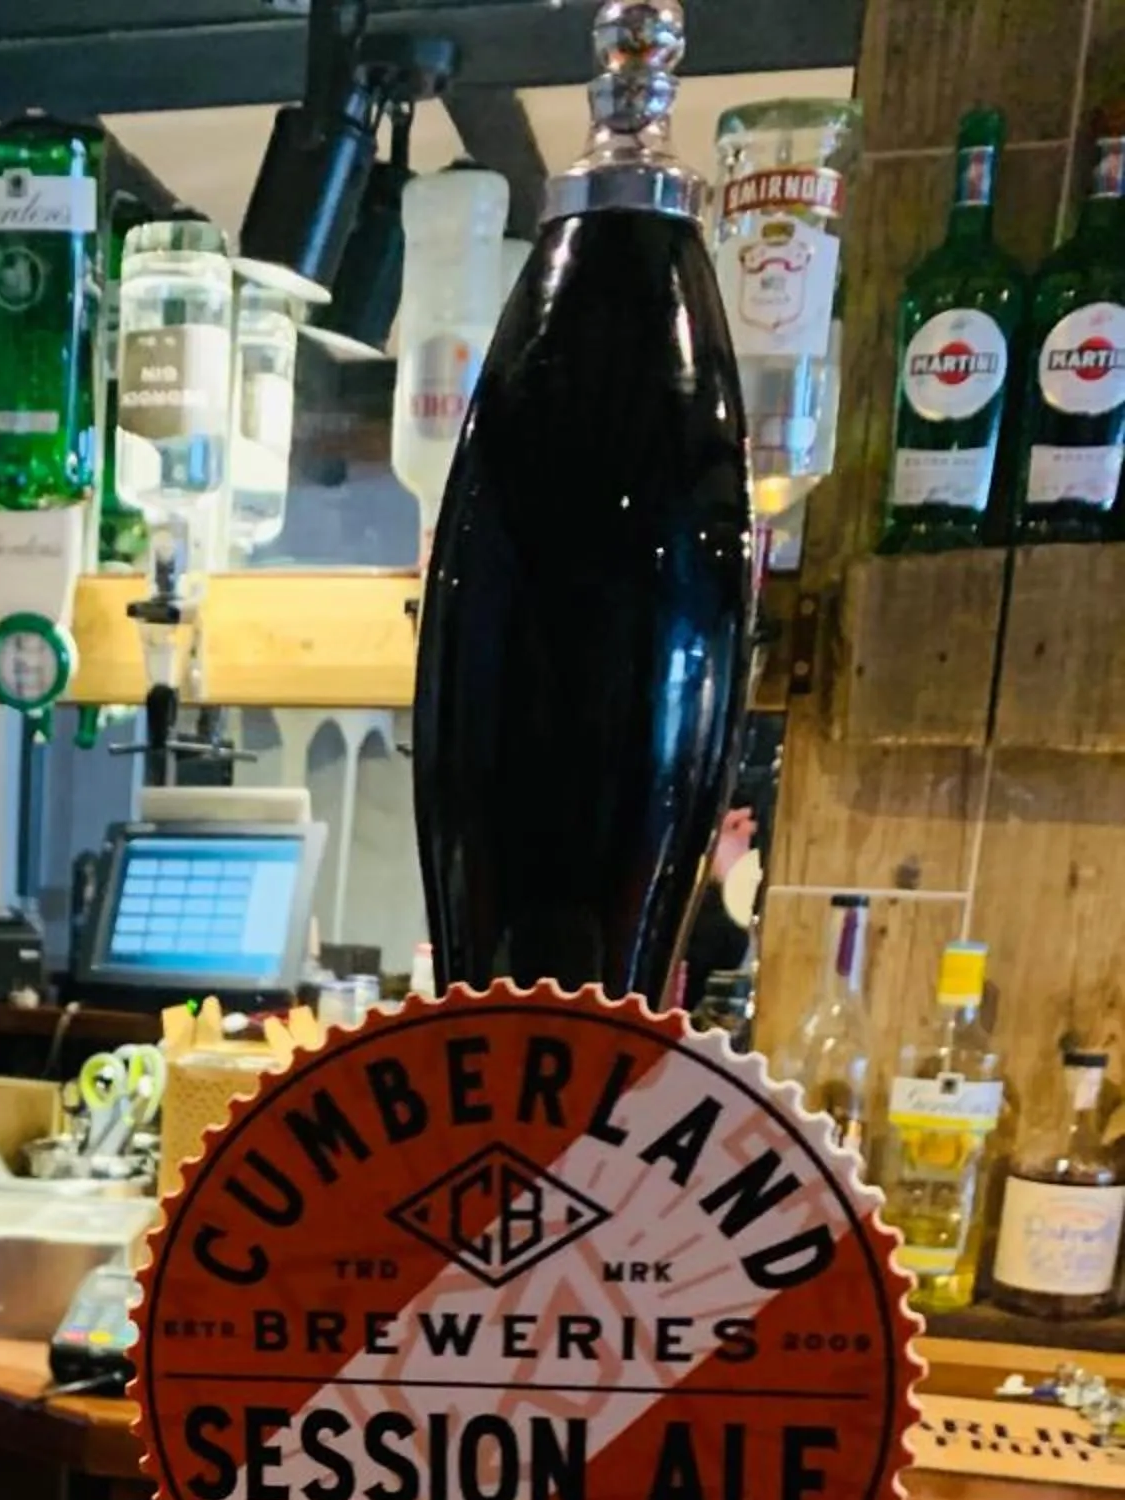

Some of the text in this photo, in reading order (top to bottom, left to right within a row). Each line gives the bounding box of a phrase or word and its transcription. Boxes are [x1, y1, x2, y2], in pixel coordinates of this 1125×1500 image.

[192, 1036, 838, 1292] CUMBERLAND
[333, 1258, 673, 1284] TRD MRK
[253, 1310, 759, 1363] BREWERIES
[784, 1333, 871, 1351] 2009
